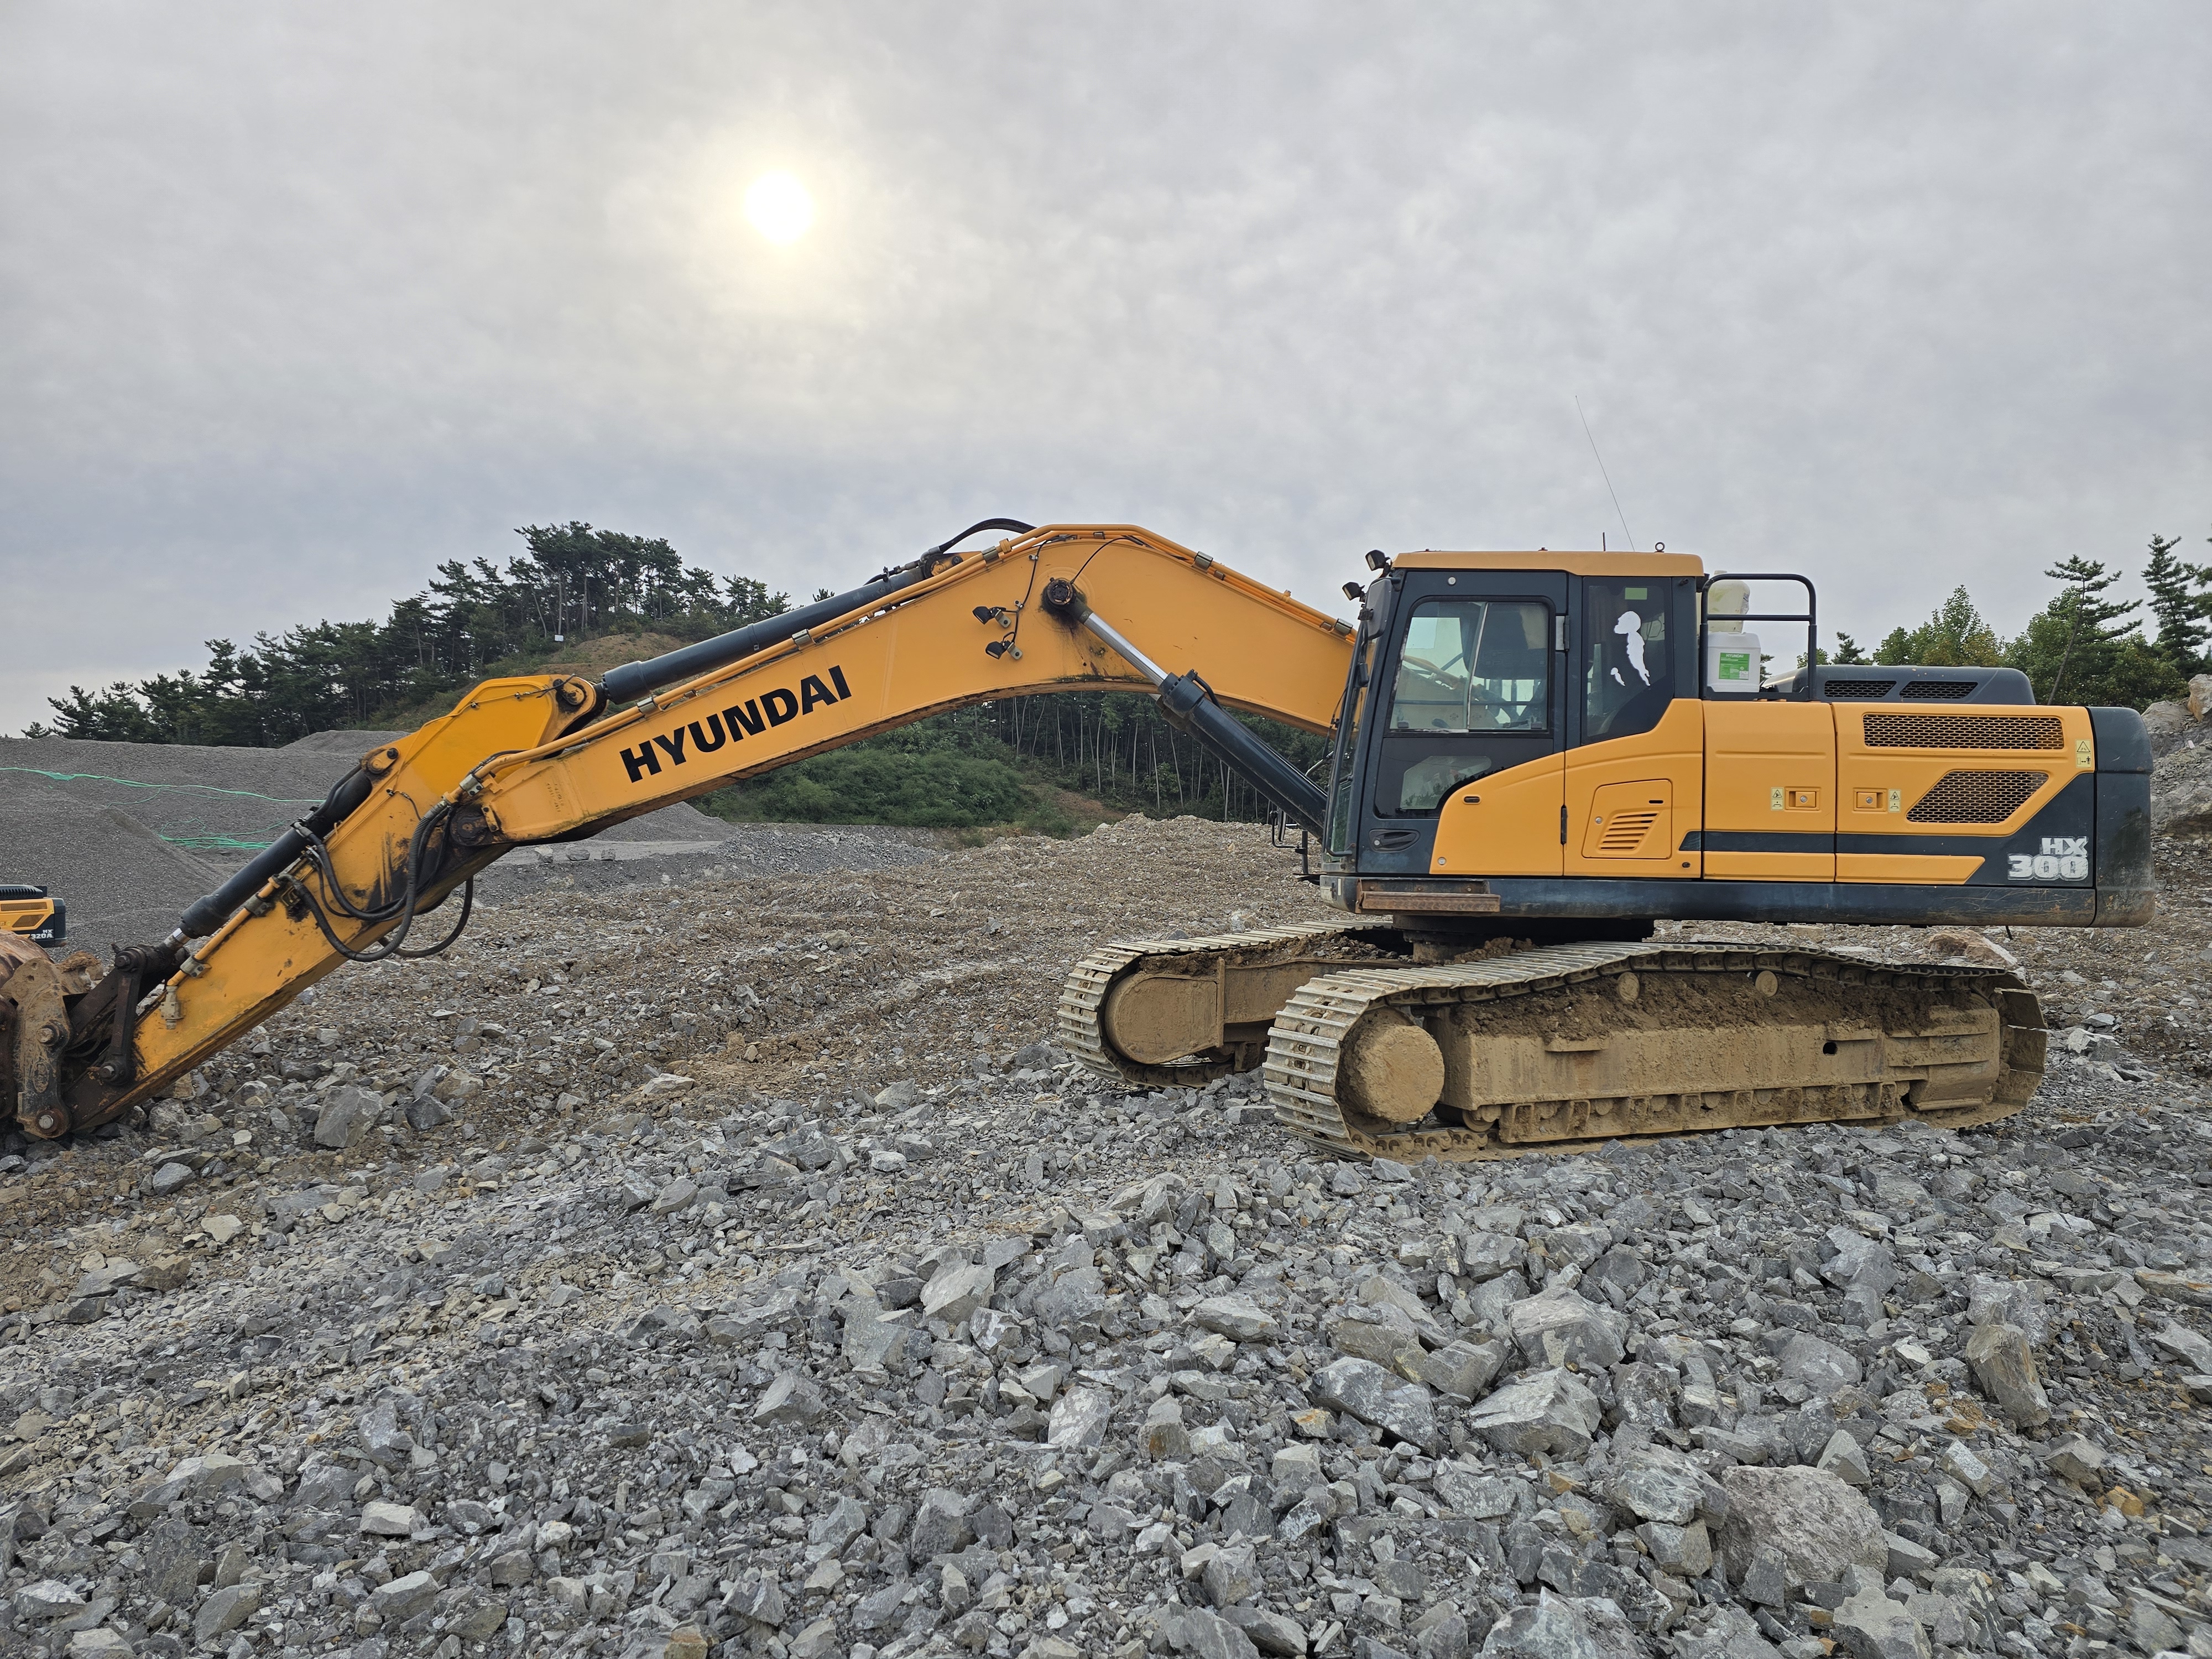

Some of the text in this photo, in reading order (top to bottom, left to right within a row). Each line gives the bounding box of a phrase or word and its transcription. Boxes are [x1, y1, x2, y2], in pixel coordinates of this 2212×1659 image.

[619, 665, 852, 783] HYUNDAI
[2041, 836, 2088, 855] HX
[2007, 854, 2089, 880] 300
